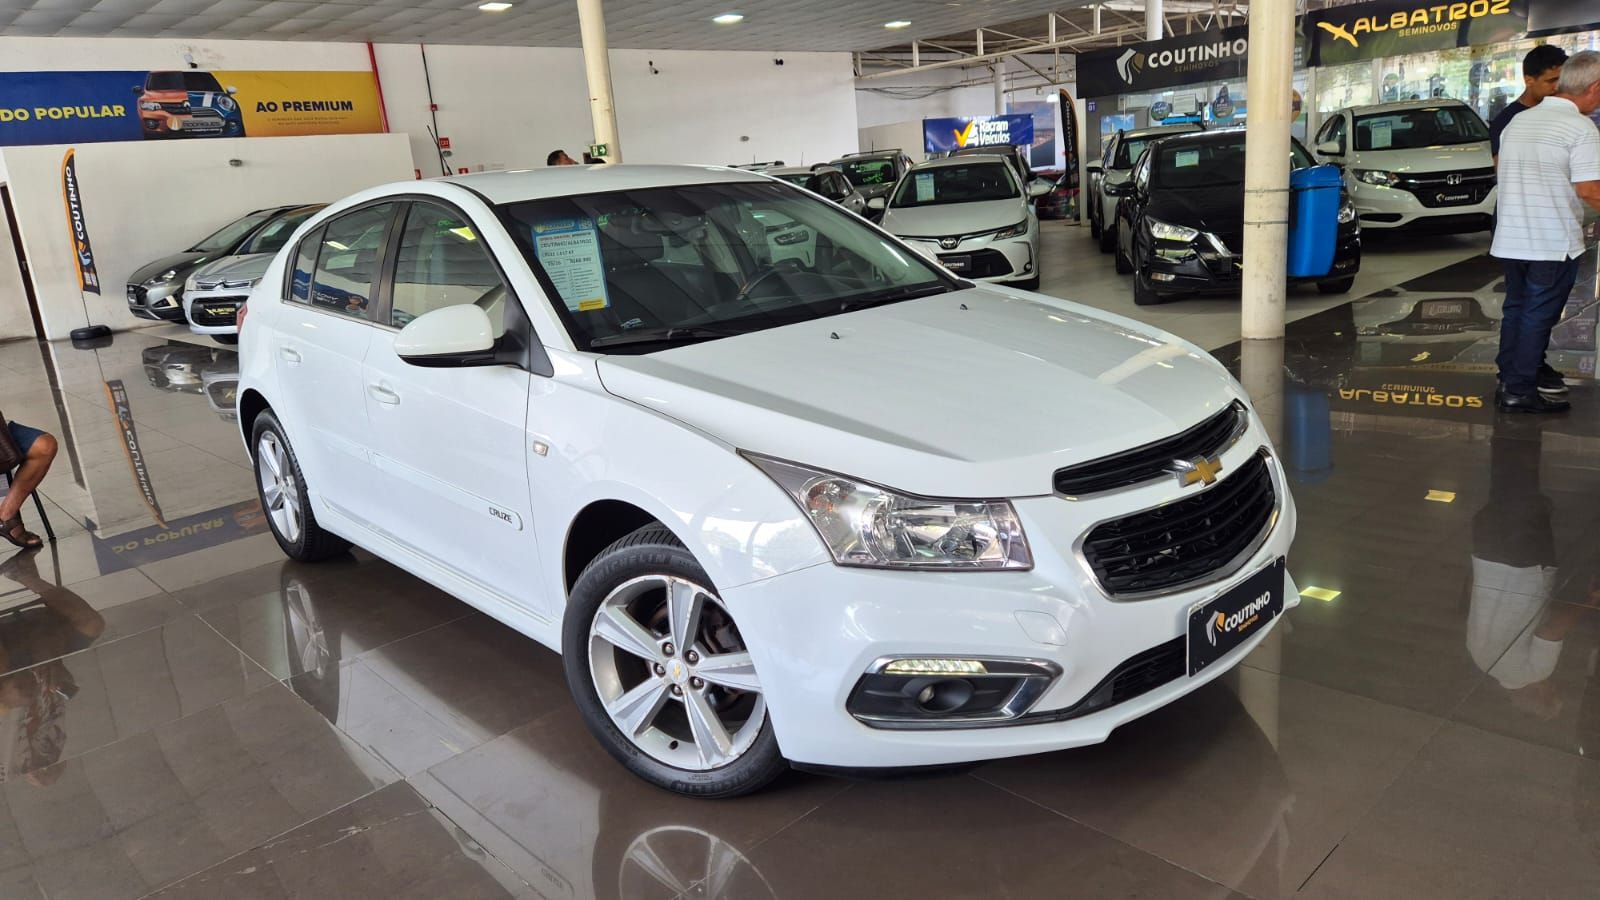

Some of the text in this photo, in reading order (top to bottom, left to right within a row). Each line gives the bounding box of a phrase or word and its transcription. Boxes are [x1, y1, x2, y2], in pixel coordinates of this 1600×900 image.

[1353, 0, 1511, 35] ALBATROZ
[1398, 22, 1457, 38] SEMINOVOS
[1147, 38, 1248, 69] COUTINHO
[1174, 61, 1220, 73] SEMINOVOS
[0, 105, 126, 122] DO POPULAR
[256, 100, 353, 112] AO PREMIUM
[979, 120, 1009, 132] Racram
[65, 166, 84, 240] COUTINHO
[488, 506, 513, 524] CRUZE
[1224, 590, 1271, 632] COUTINHO
